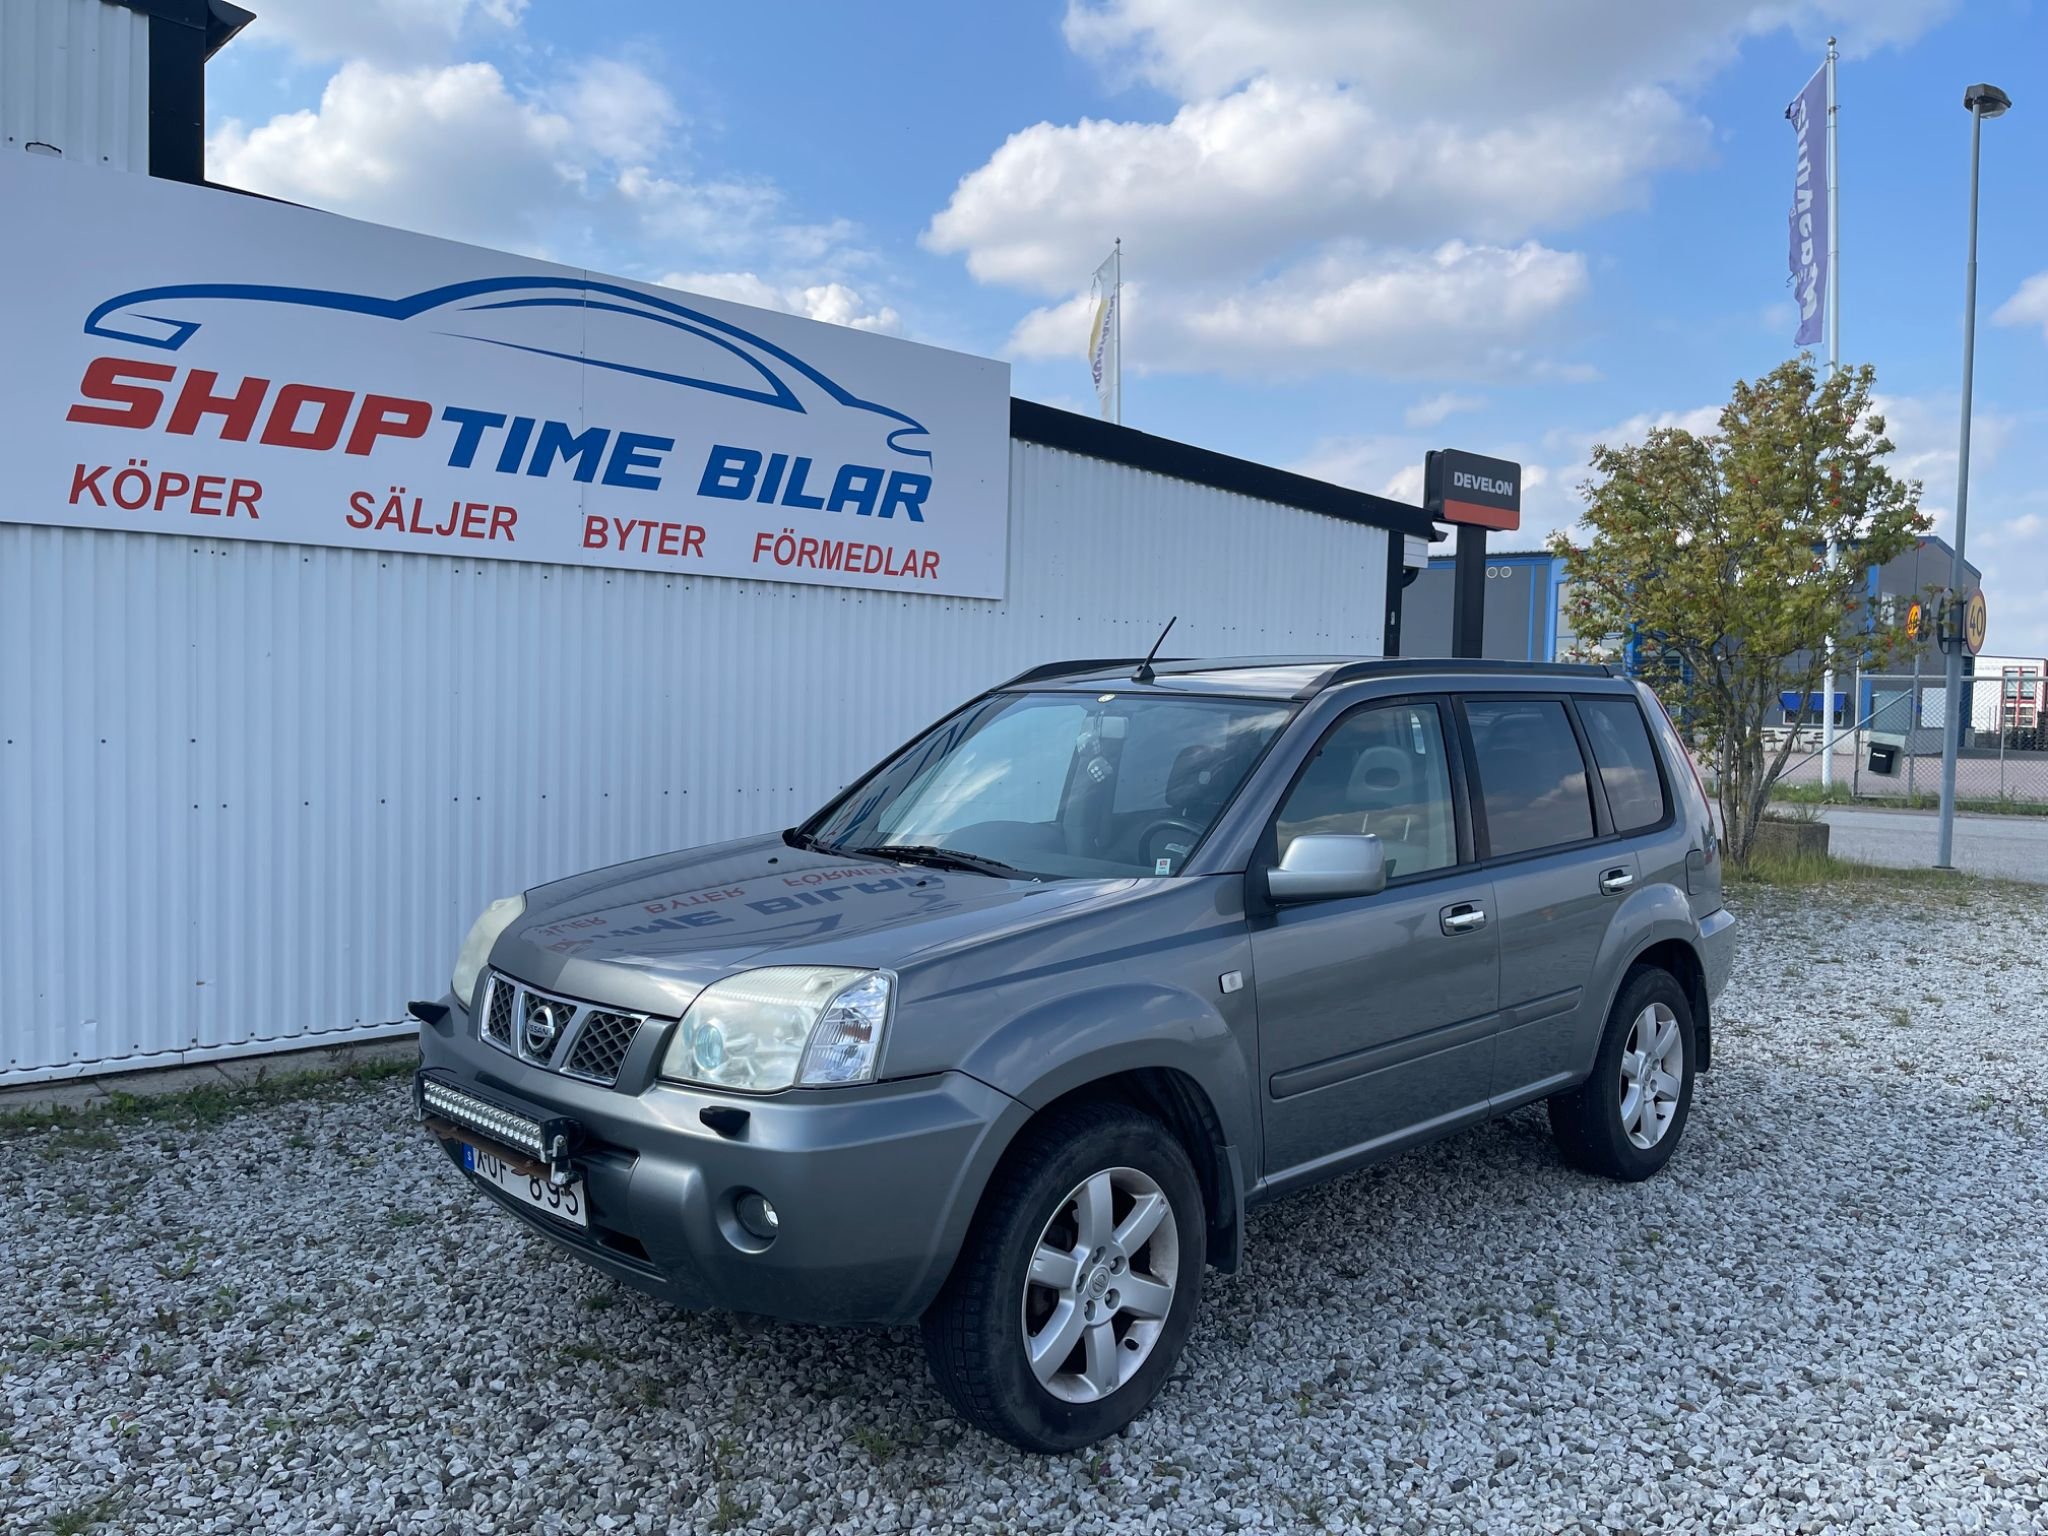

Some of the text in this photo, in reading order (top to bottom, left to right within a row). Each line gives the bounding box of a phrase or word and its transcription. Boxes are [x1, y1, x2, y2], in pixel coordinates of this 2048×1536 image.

[696, 444, 933, 523] BILAR
[1453, 471, 1514, 497] DEVELON
[68, 458, 941, 580] KÖPER SÄLJER BYTER FÖRMEDLAR
[1969, 605, 1984, 637] 40
